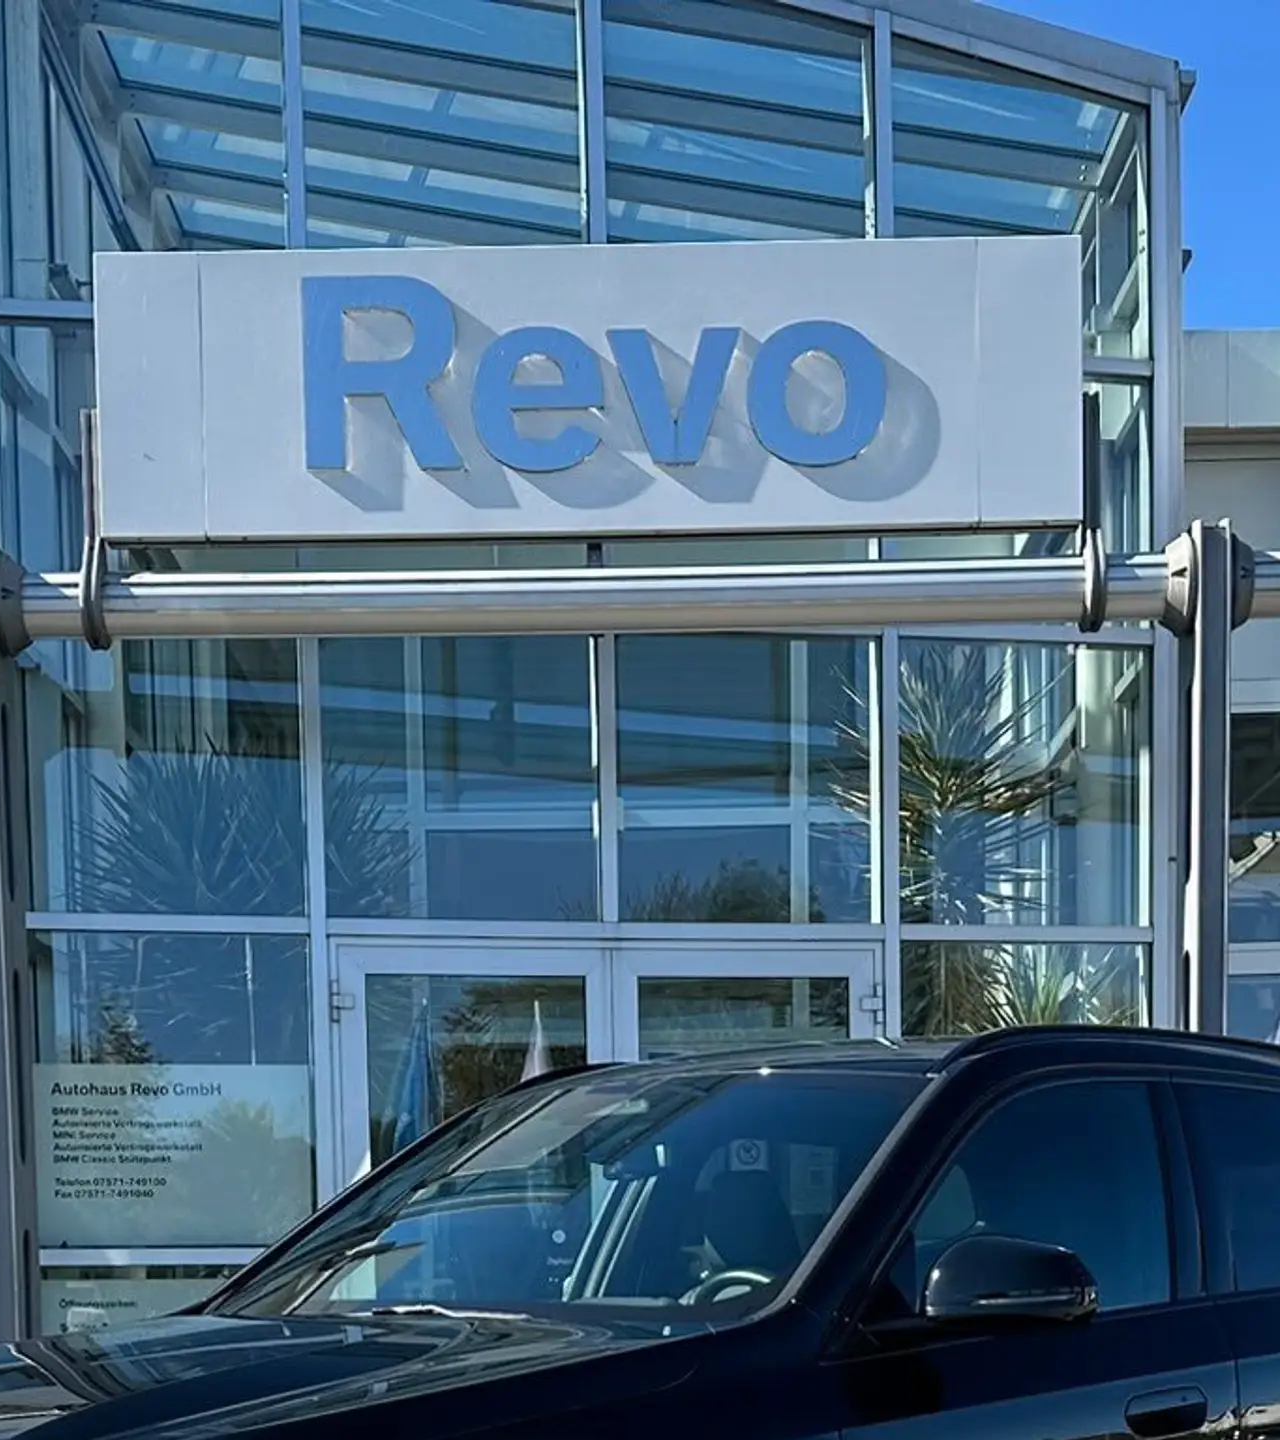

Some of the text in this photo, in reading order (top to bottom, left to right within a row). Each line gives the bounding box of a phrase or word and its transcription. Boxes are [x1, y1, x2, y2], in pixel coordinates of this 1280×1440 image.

[300, 275, 887, 471] Revo
[51, 1083, 221, 1096] Autohaus Revo GmbH
[81, 1107, 119, 1116] Service
